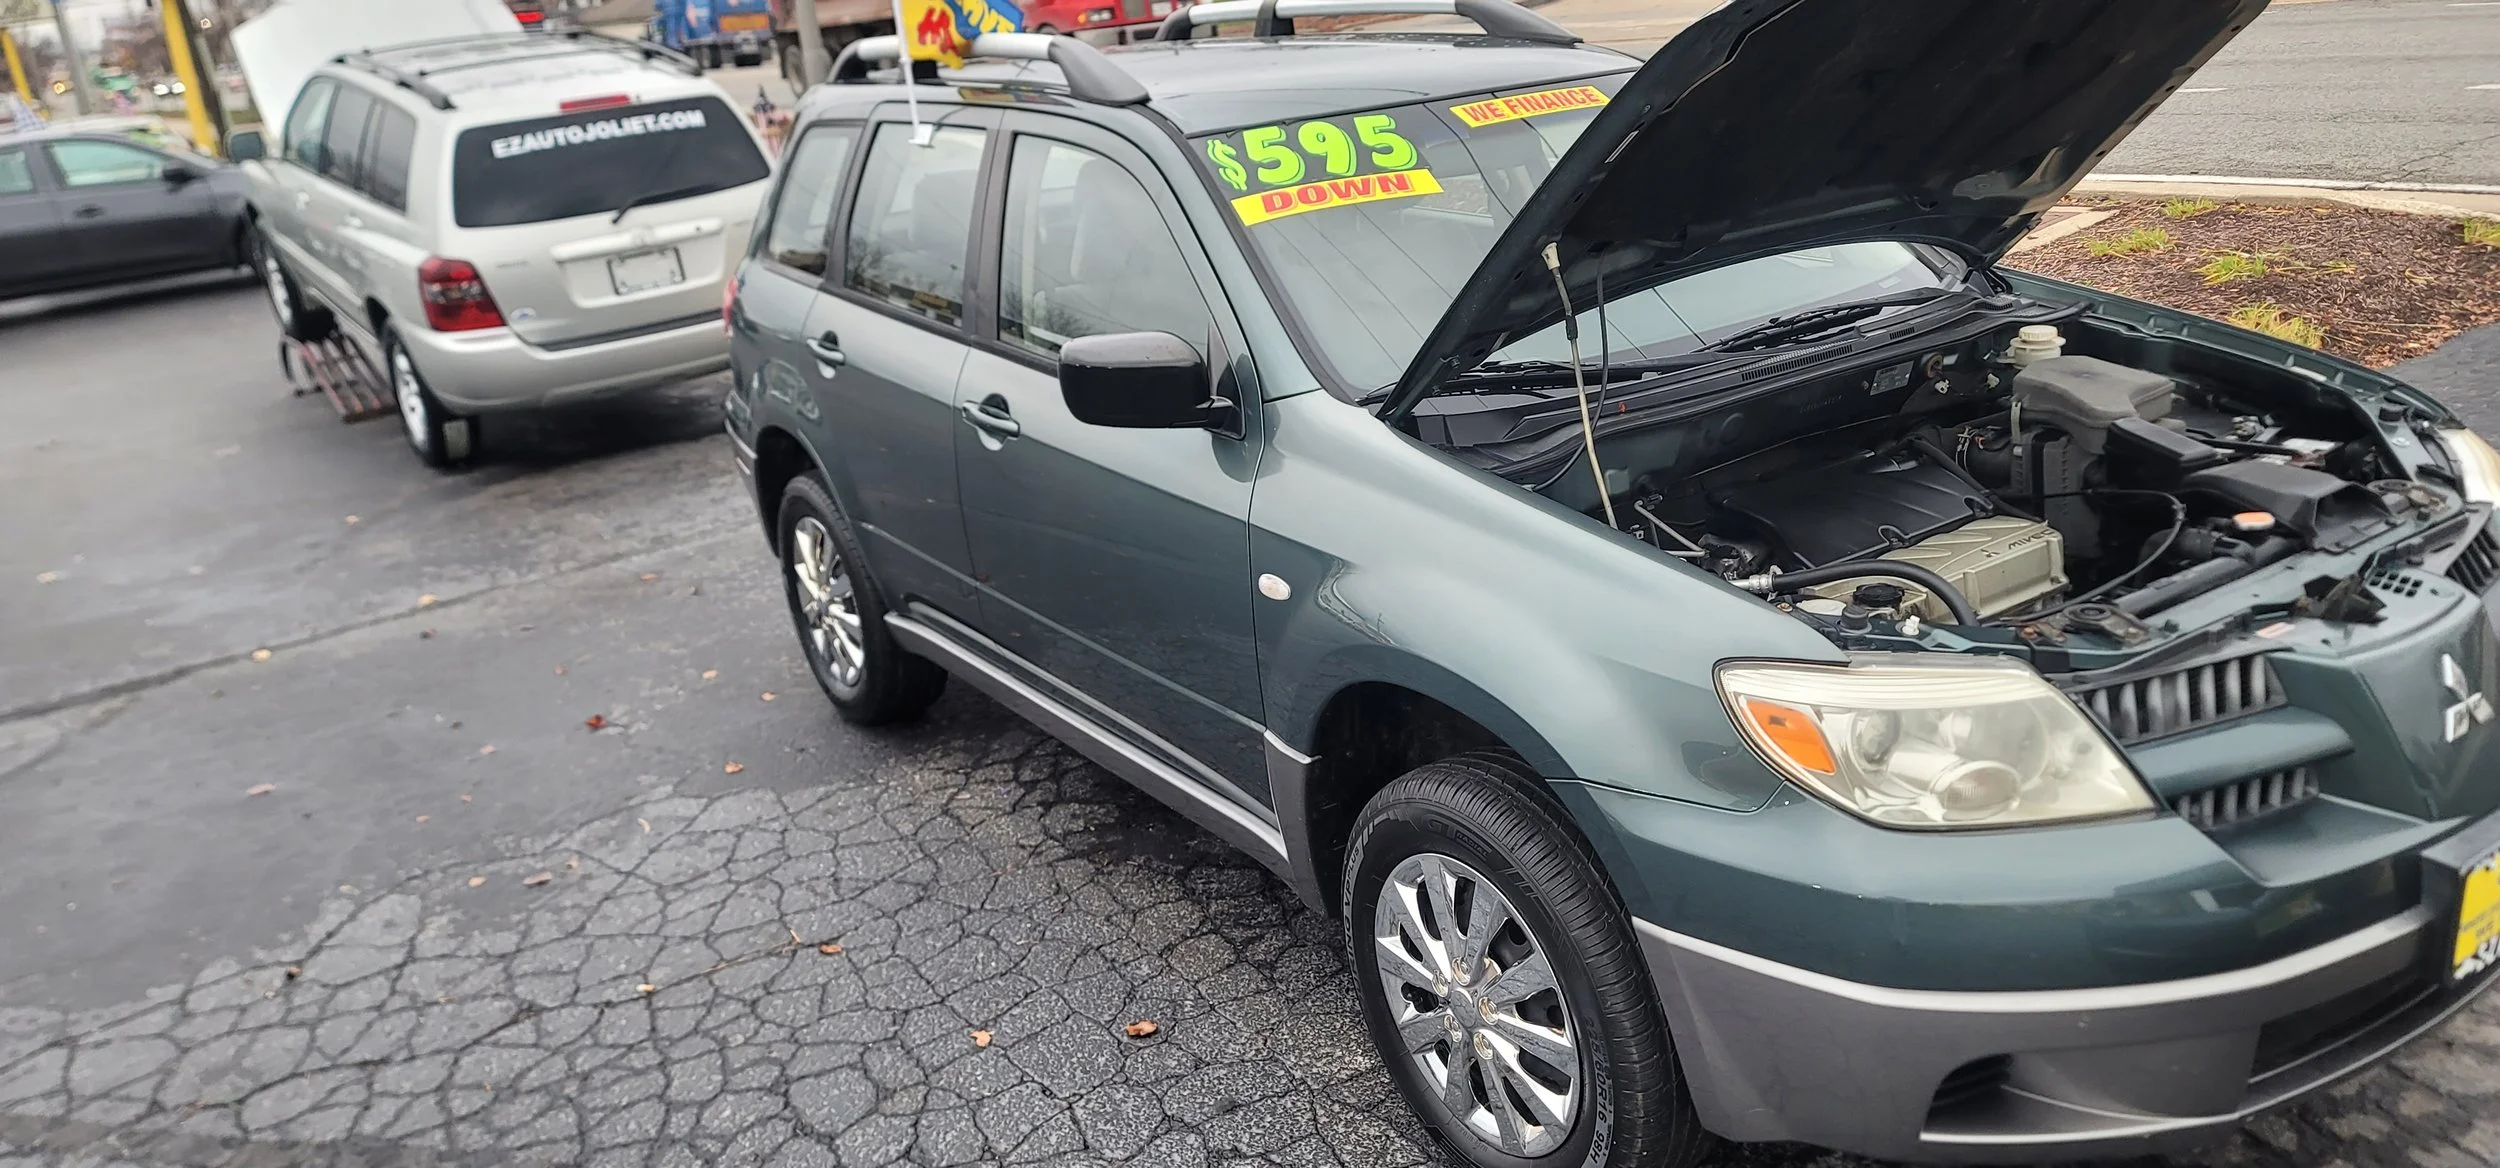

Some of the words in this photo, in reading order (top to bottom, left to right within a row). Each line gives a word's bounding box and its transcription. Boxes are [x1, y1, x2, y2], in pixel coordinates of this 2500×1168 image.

[1463, 103, 1504, 121] WE
[1504, 89, 1599, 112] FINANCE
[491, 109, 707, 159] EZAUTOJOLIET.COM
[1206, 114, 1417, 191] $595
[1261, 173, 1415, 214] DOWN
[1589, 1129, 1606, 1164] 98H
